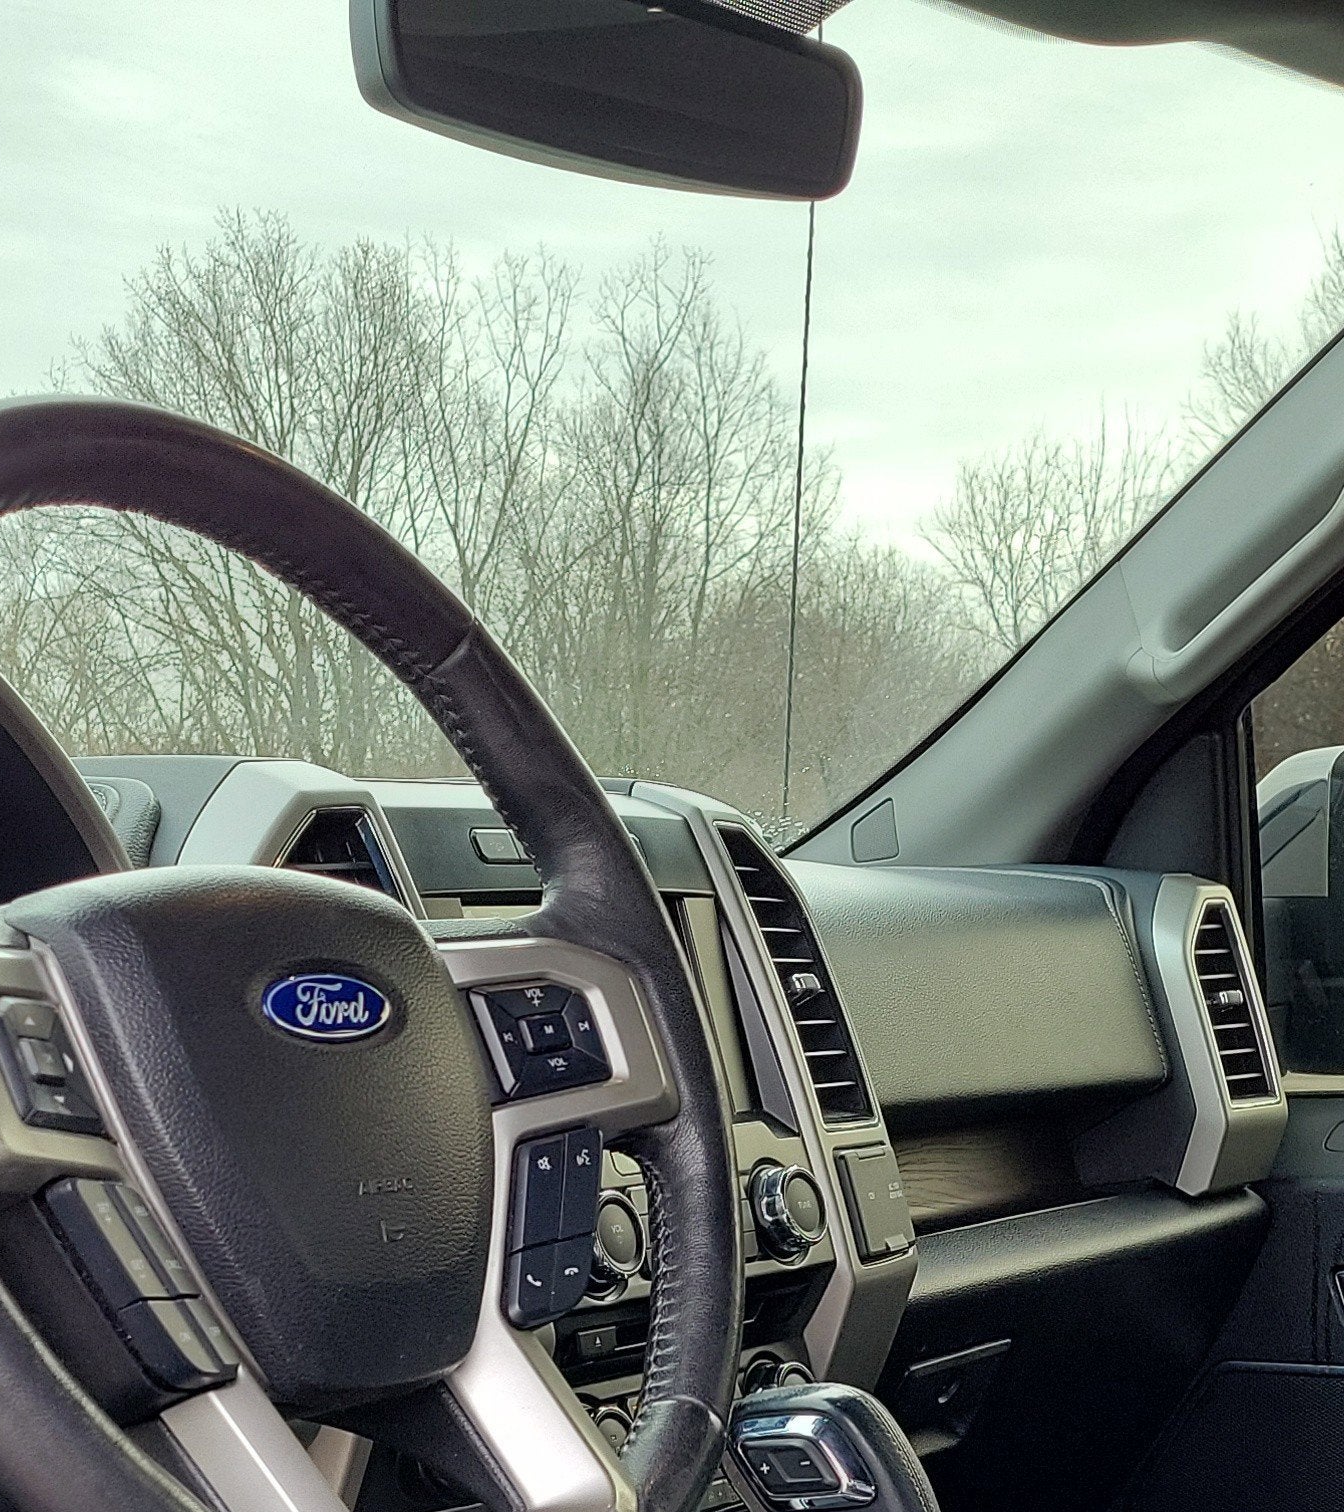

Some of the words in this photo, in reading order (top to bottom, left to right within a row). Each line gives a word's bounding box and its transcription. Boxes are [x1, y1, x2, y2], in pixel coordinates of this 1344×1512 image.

[524, 988, 545, 998] VOL
[294, 981, 371, 1027] Ford
[543, 1025, 554, 1035] M
[547, 1057, 568, 1067] VOL
